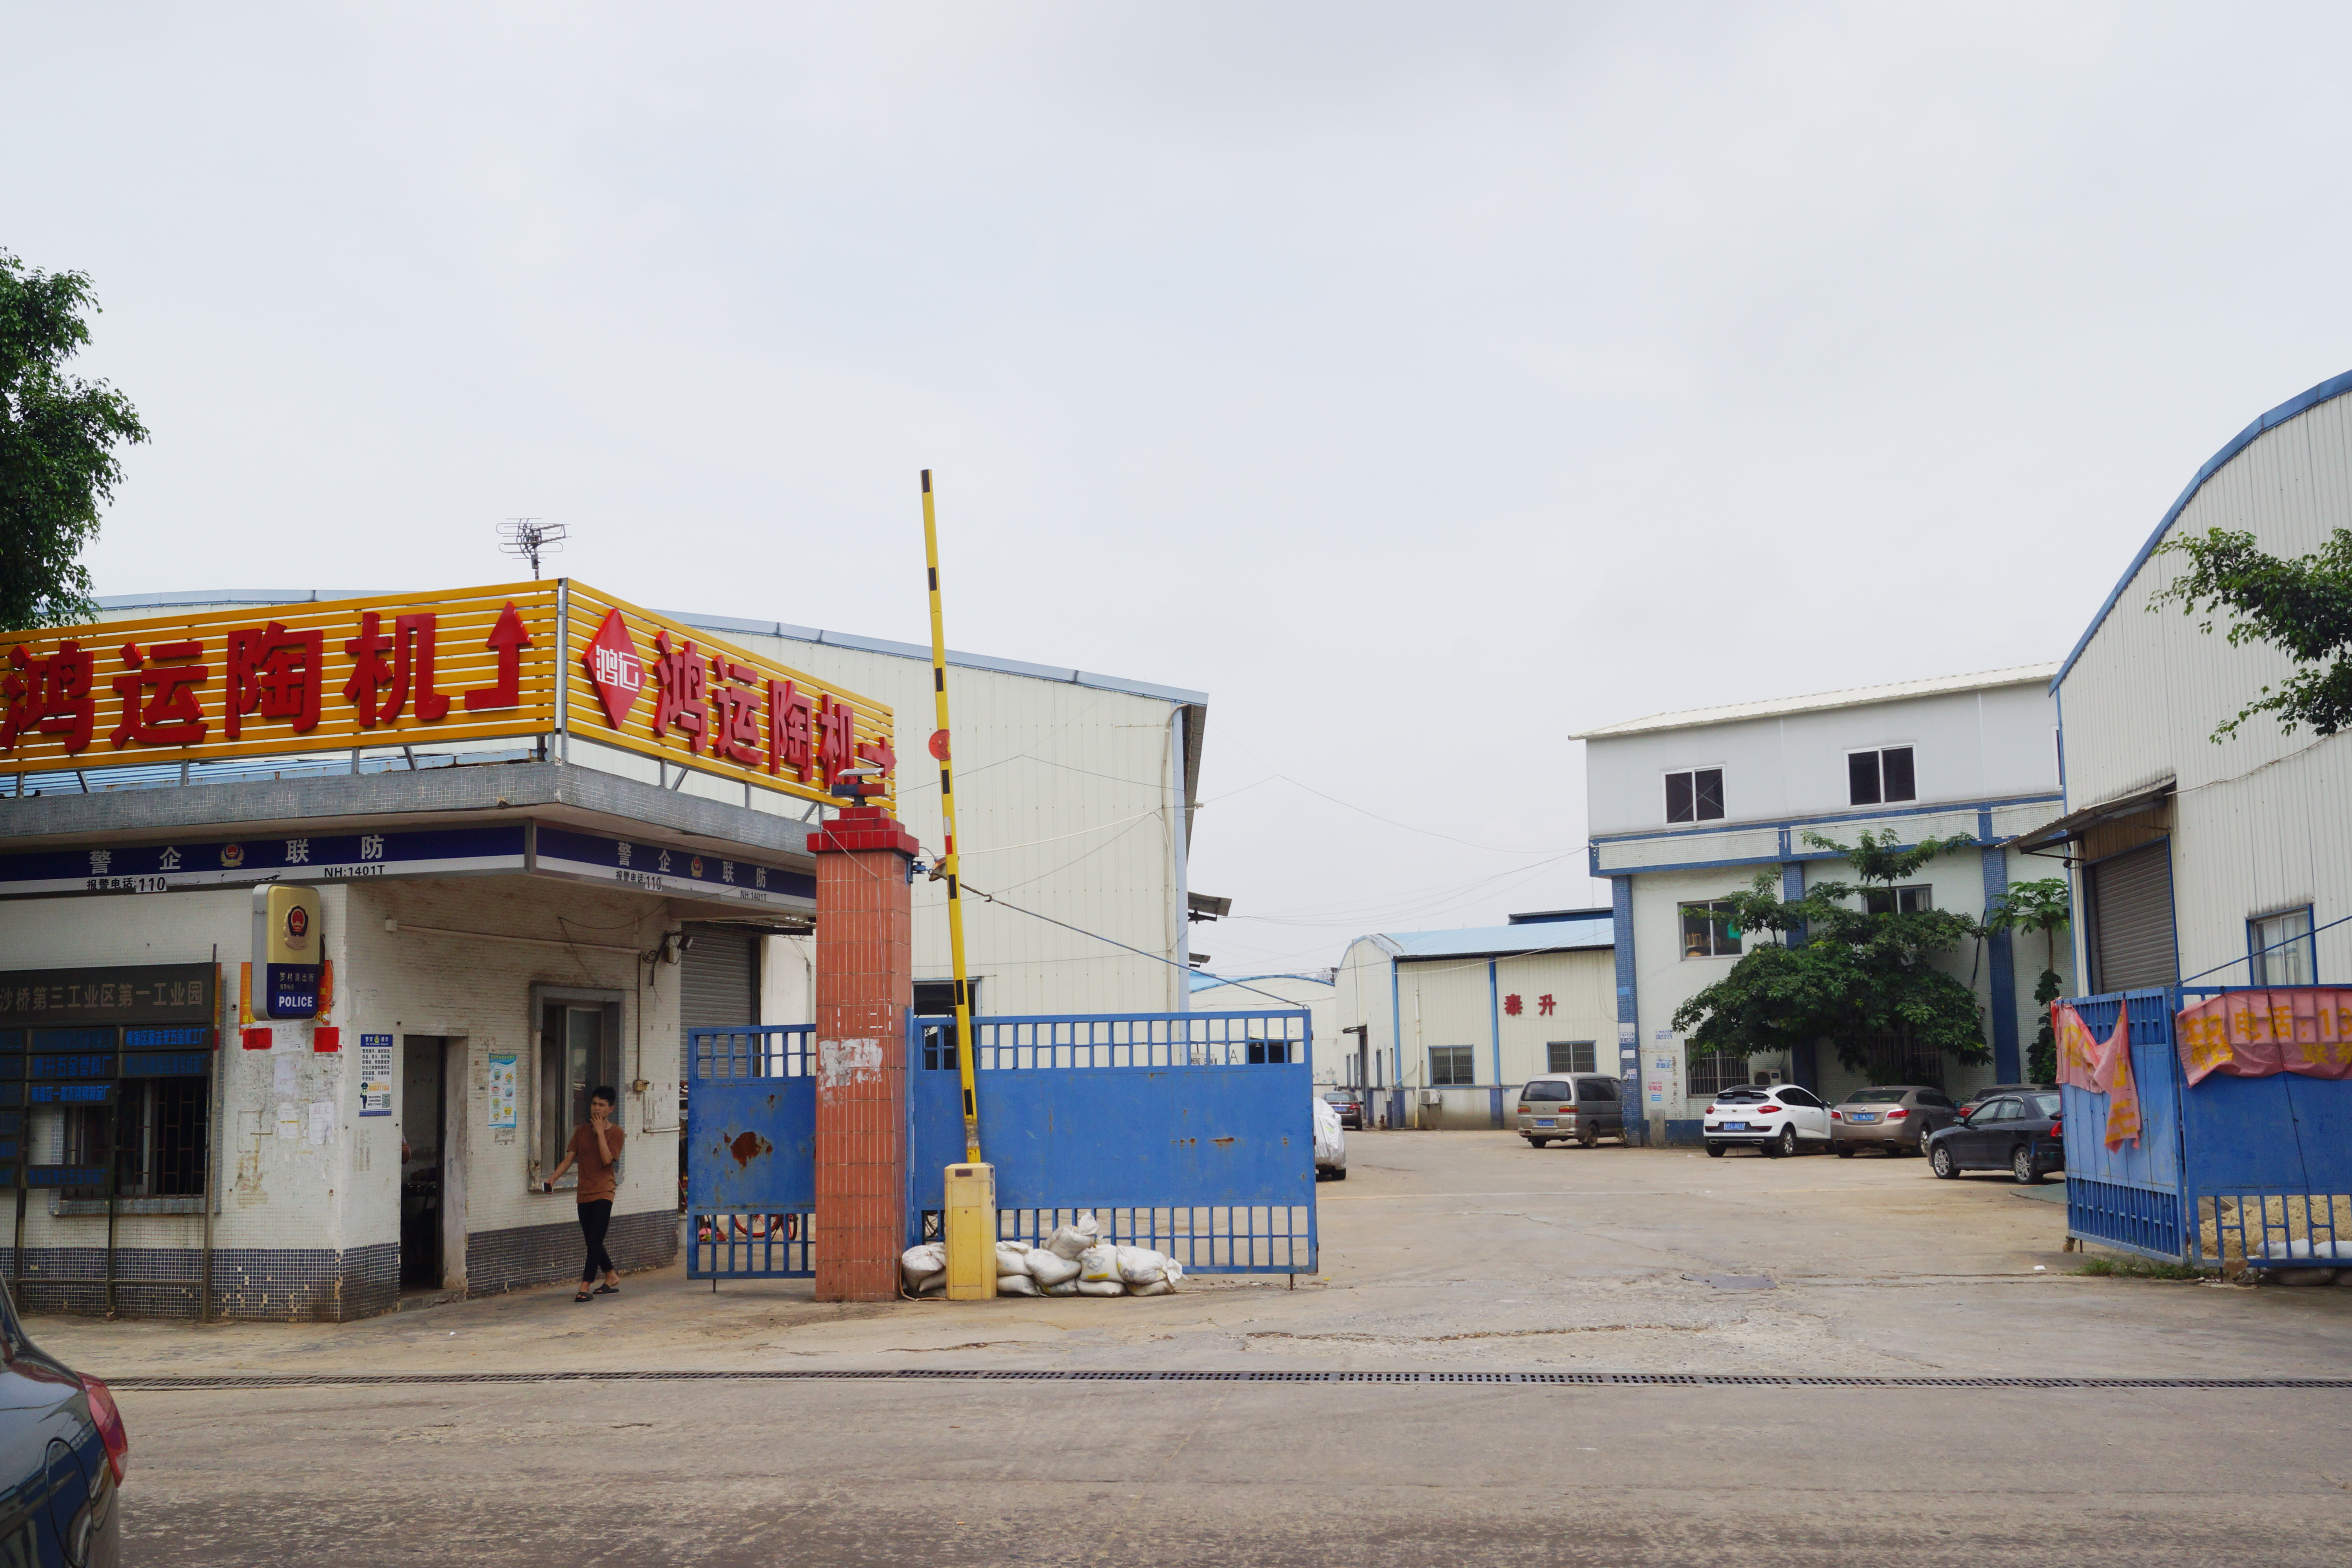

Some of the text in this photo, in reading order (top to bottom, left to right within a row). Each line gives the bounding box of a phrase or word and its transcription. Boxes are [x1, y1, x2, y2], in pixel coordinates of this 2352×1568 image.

[0, 612, 450, 753] 鸿运陶机
[652, 630, 858, 789] 鸿运陶机
[325, 865, 385, 877] NH:1401T
[279, 972, 314, 982] 罗村派出所
[279, 996, 313, 1007] POLICE
[1504, 993, 1557, 1016] 泰升
